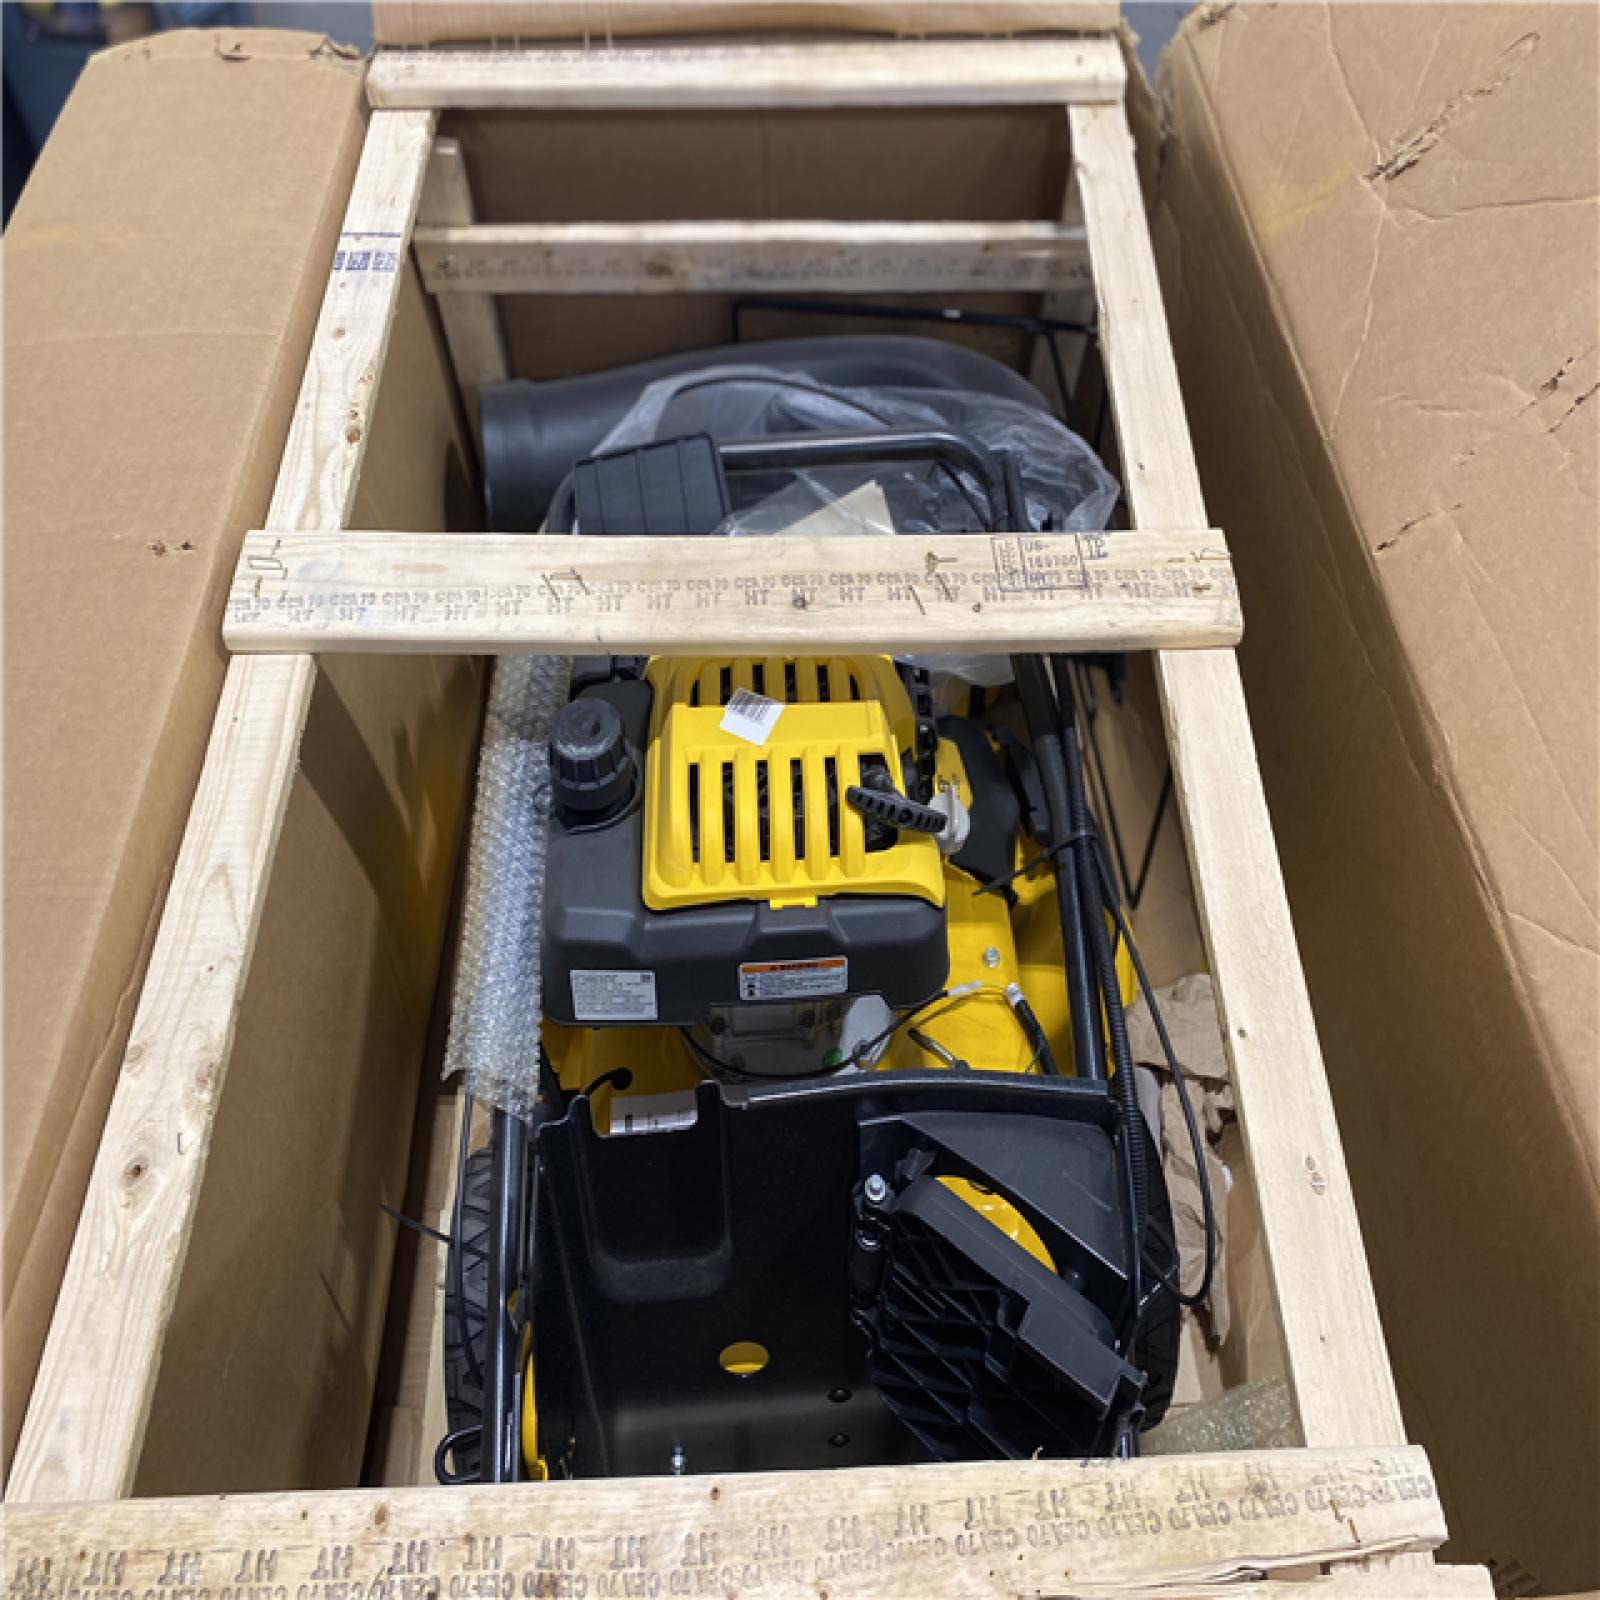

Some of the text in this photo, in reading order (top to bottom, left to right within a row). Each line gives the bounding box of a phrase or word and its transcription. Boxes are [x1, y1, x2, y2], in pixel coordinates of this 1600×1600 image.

[234, 1549, 277, 1583] HT
[310, 1544, 353, 1580] HT
[388, 1540, 429, 1575] HT
[462, 1536, 502, 1570] HT
[534, 1536, 576, 1570] HT
[610, 1534, 648, 1570] HT
